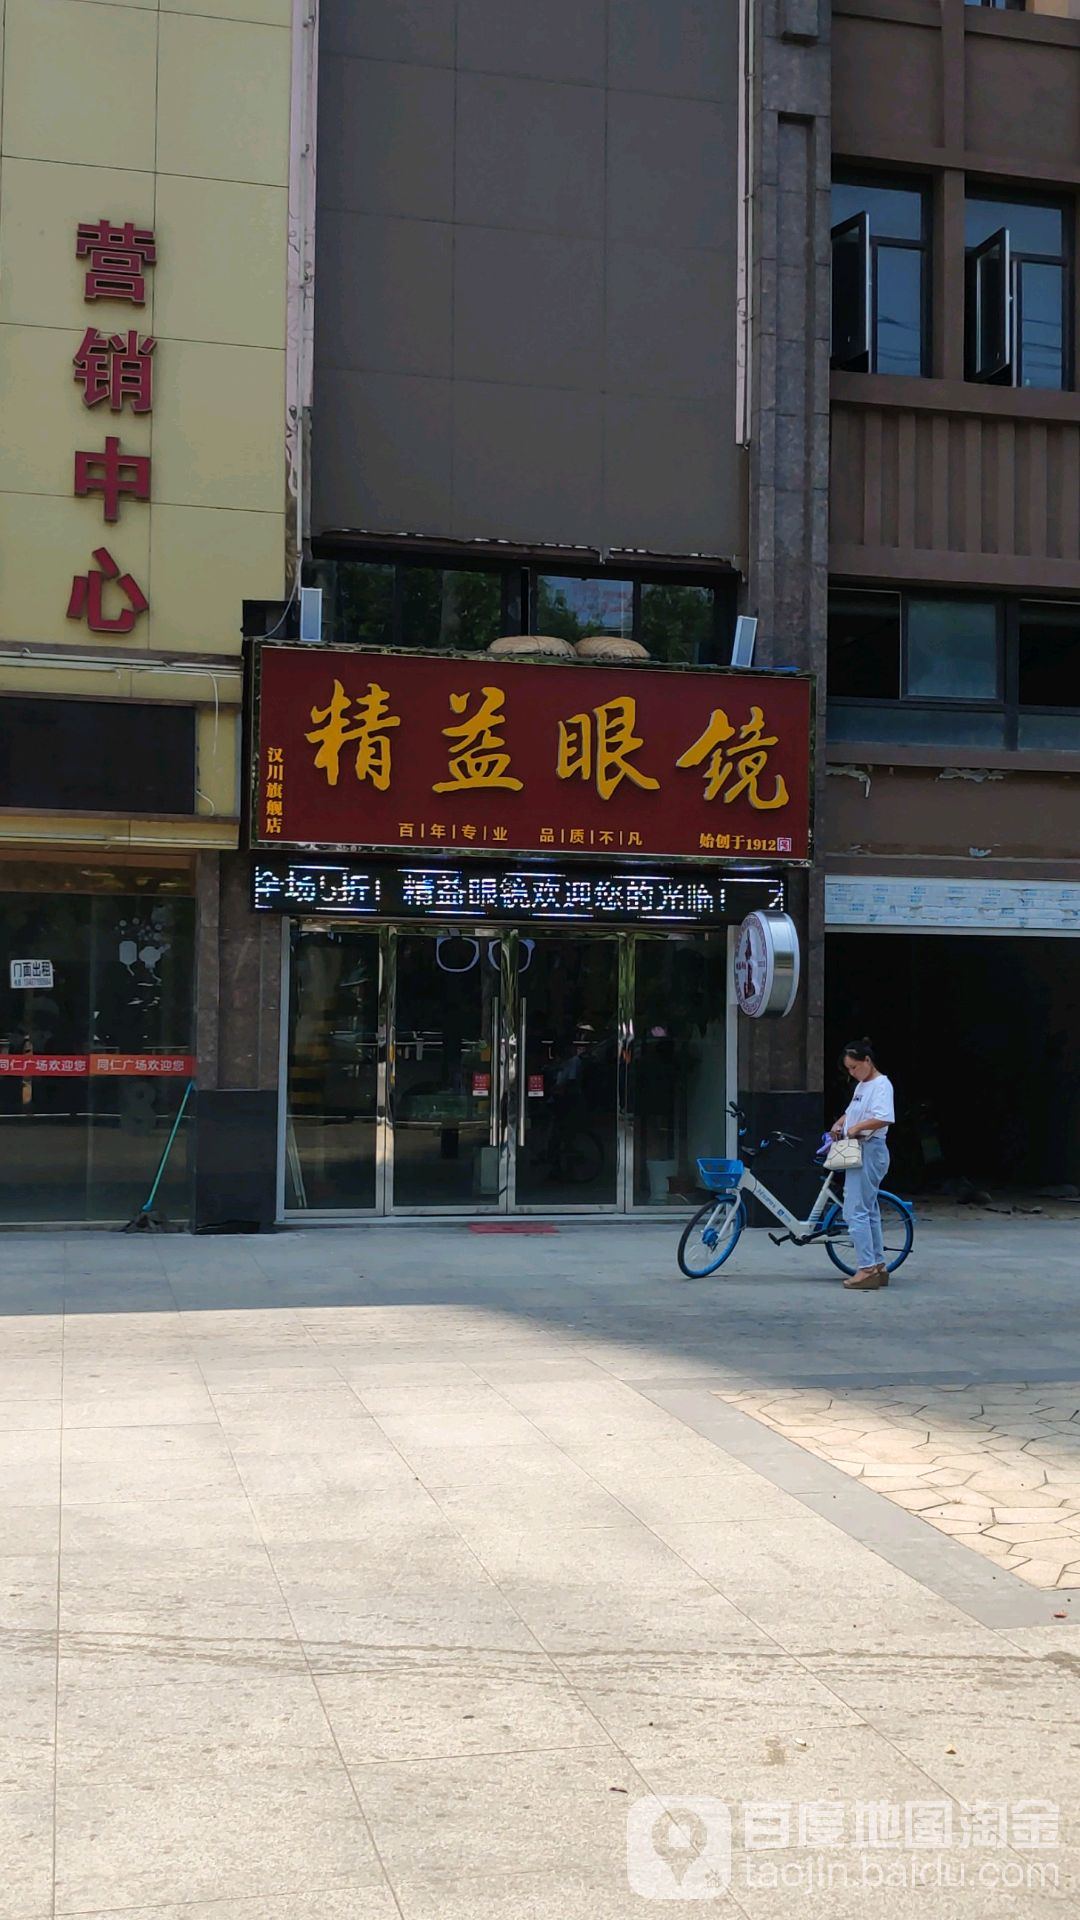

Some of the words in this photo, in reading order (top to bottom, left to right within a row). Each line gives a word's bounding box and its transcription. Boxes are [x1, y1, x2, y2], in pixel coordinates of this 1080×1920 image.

[66, 219, 157, 633] 营销中心
[305, 678, 791, 812] 精益眼镜
[265, 746, 284, 834] 汉川旗舰店
[699, 832, 777, 851] 始创于1912
[14, 961, 51, 977] 门面出租
[0, 1058, 87, 1072] 同仁广场欢迎您
[96, 1058, 184, 1072] 同仁广场欢迎您
